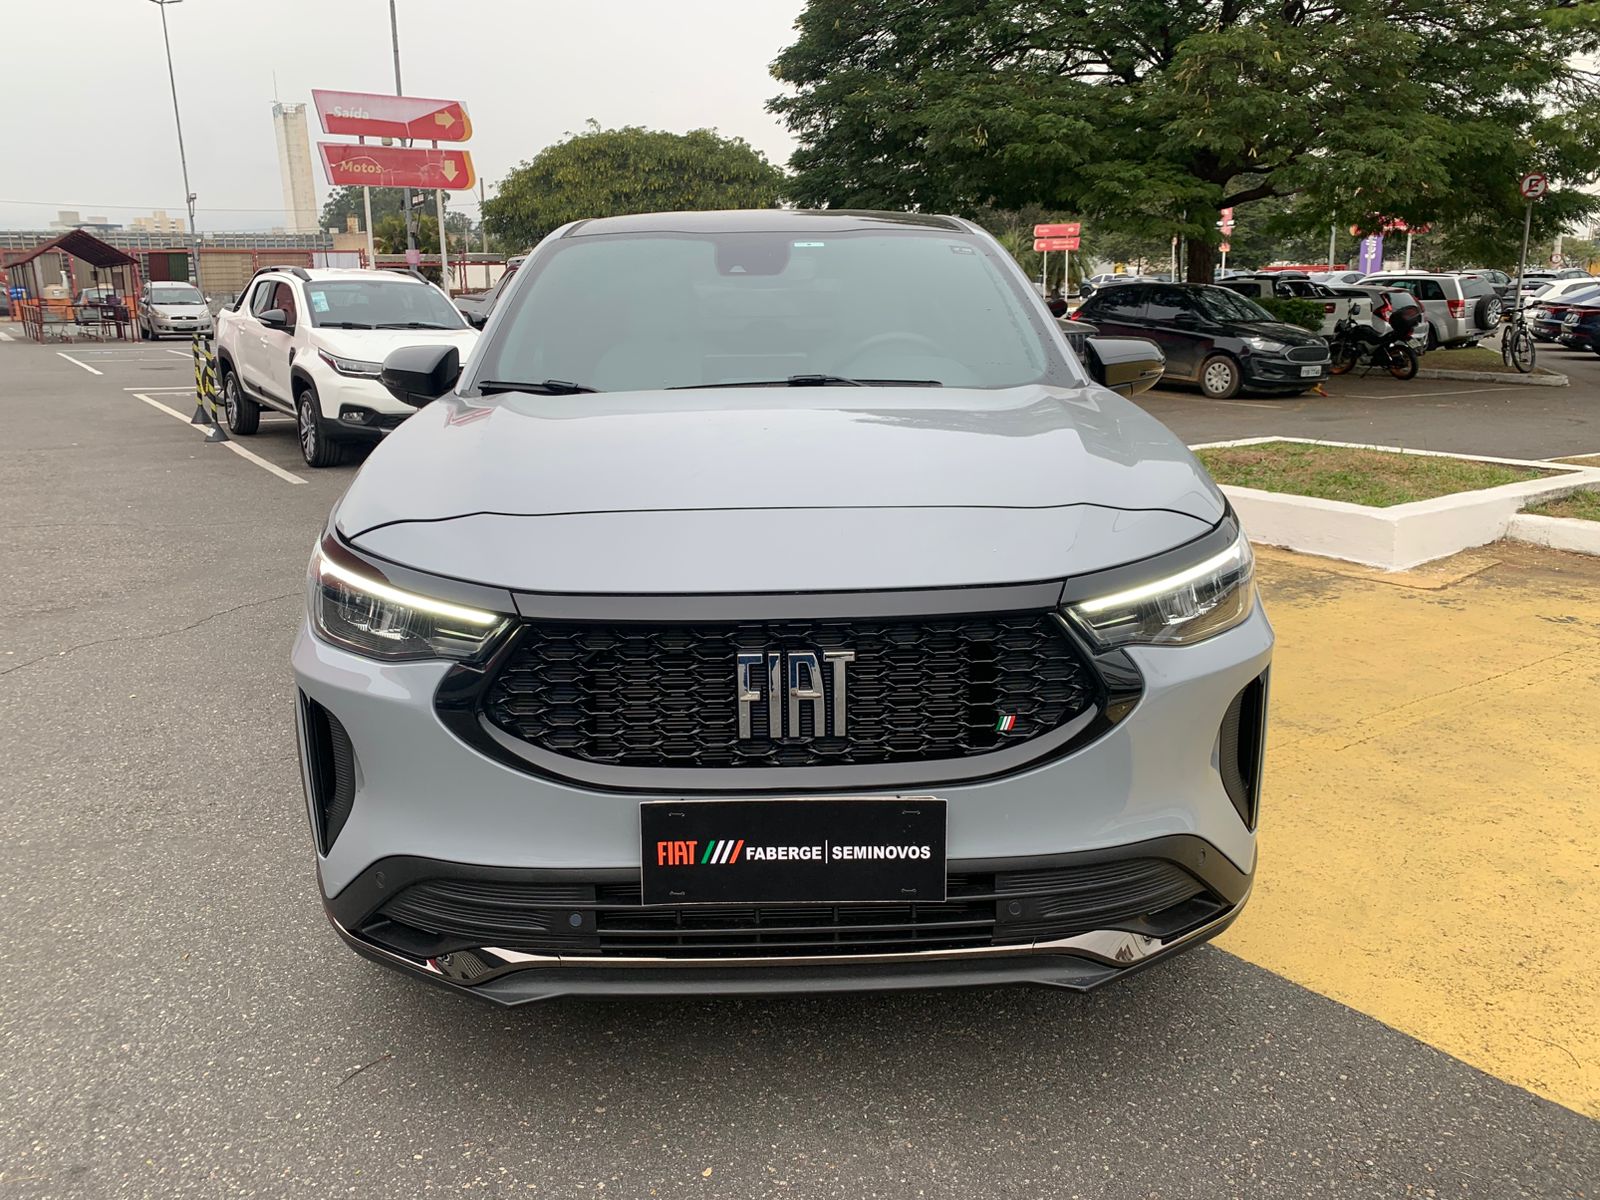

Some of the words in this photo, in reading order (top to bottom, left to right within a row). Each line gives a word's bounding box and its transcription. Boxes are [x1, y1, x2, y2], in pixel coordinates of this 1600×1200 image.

[334, 106, 369, 120] Saída
[340, 160, 382, 174] Motos
[736, 649, 856, 740] FIAT
[656, 840, 698, 866] FIAT
[745, 845, 822, 861] FABERGE
[832, 845, 931, 860] SEMINOVOS
